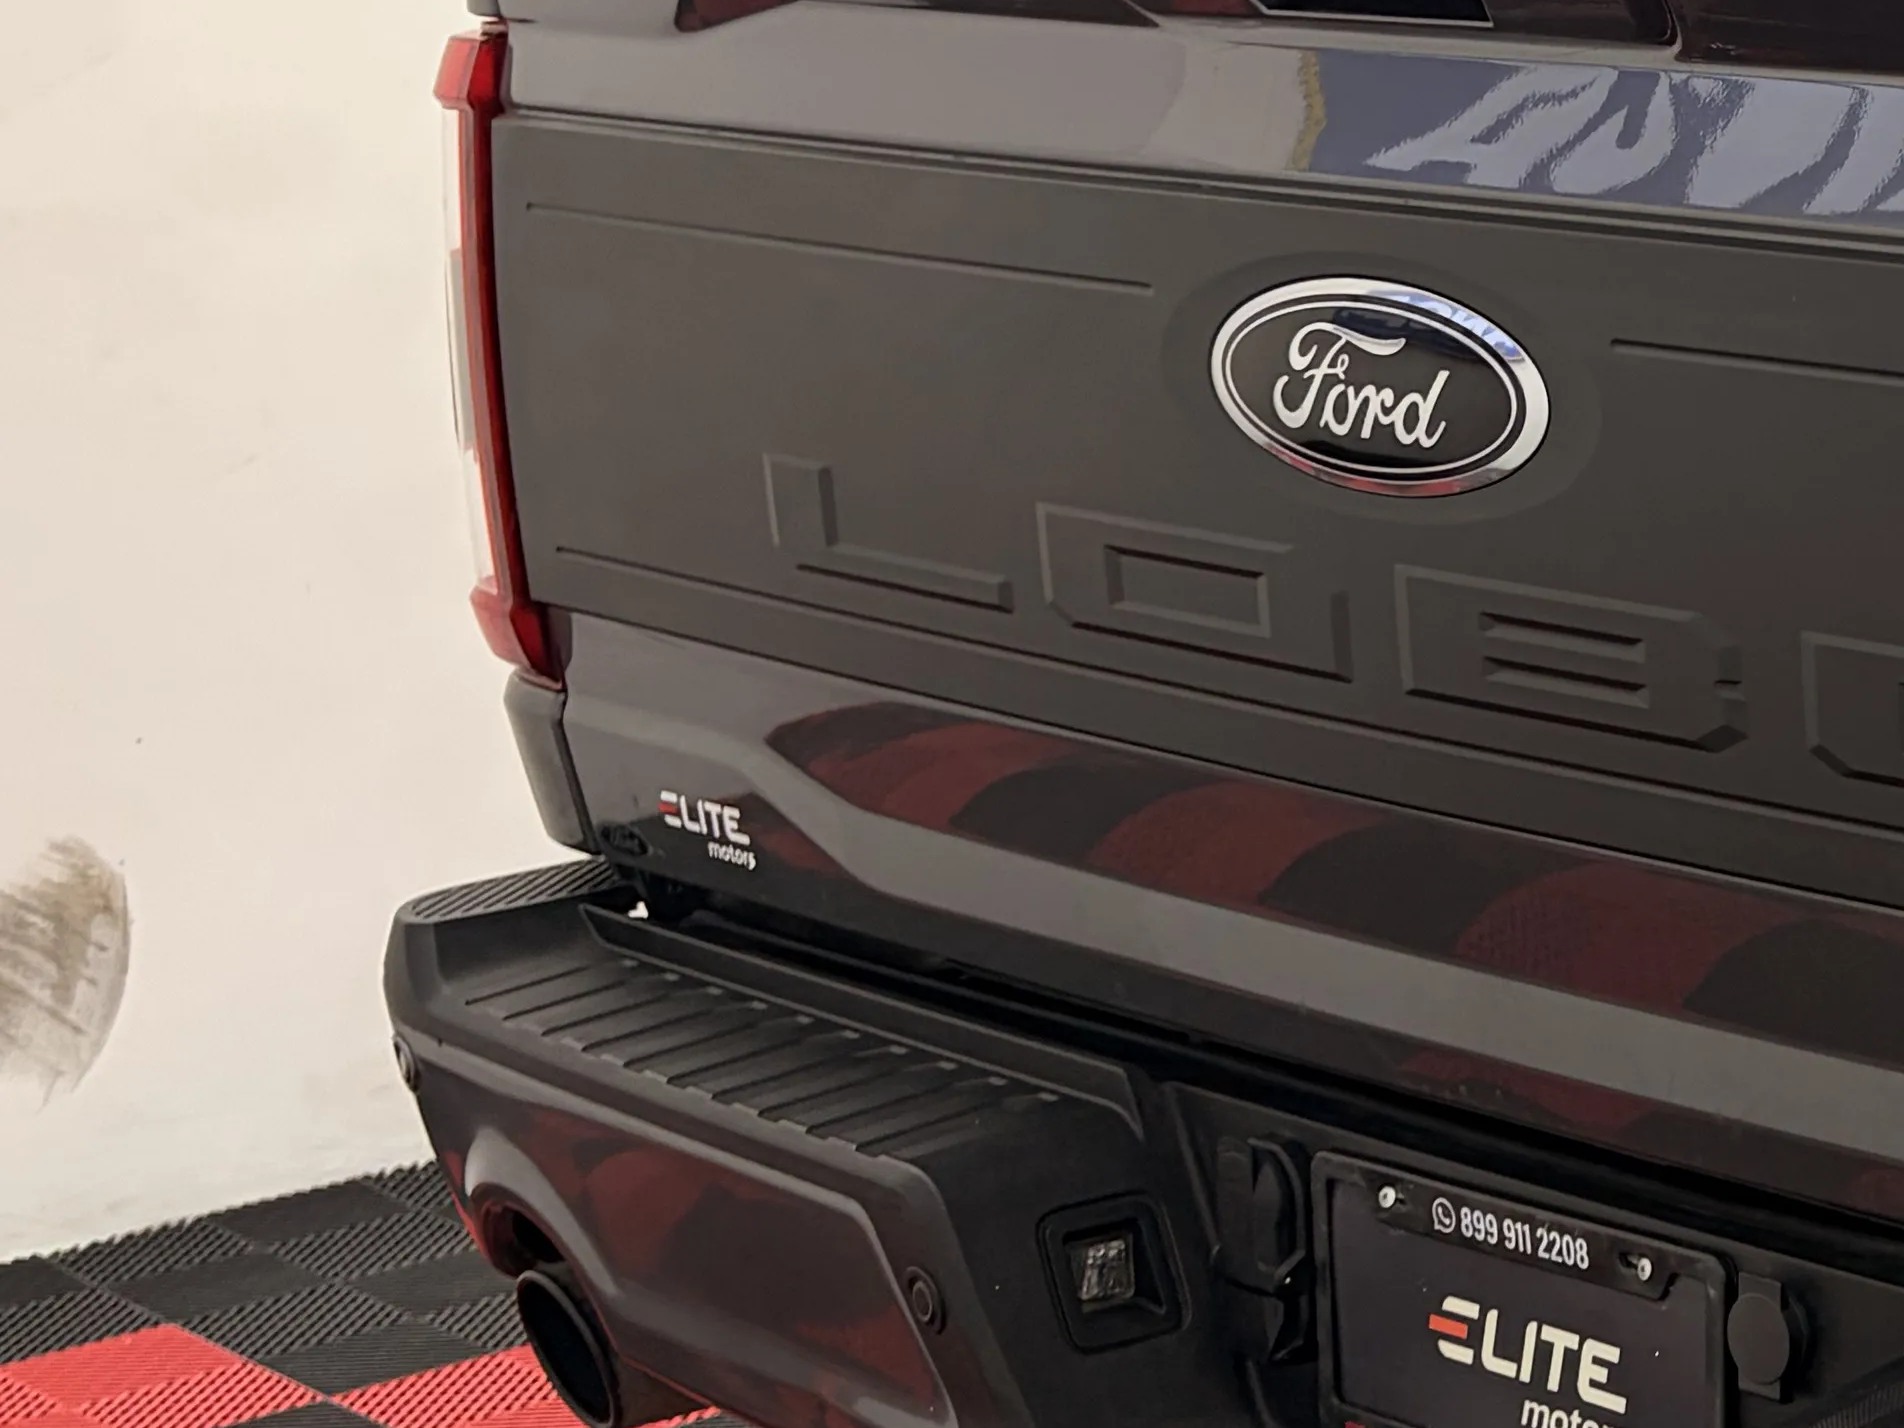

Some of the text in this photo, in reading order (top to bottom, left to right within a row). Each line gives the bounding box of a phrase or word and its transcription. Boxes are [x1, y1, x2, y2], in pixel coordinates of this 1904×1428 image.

[1272, 321, 1451, 449] Ford
[657, 789, 751, 847] ELITE
[707, 841, 757, 871] motors
[1460, 1206, 1590, 1271] 899 911 2208
[1428, 1295, 1627, 1415] ELITE
